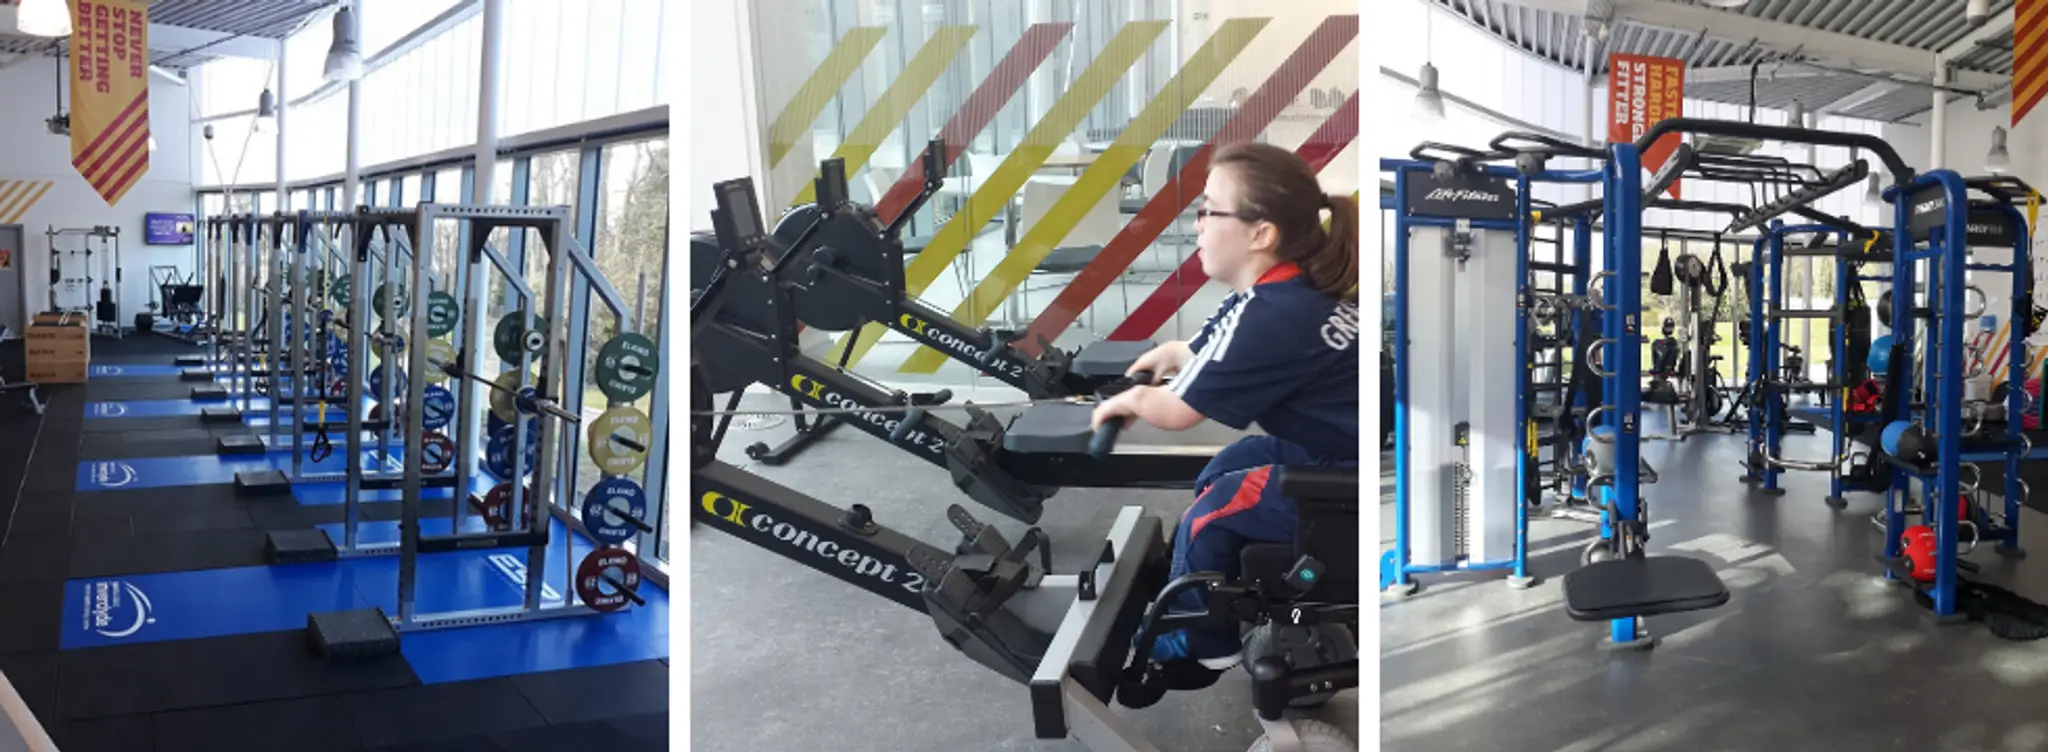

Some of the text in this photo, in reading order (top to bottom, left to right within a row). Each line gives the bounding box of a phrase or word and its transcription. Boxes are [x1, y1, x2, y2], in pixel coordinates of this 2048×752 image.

[78, 1, 93, 81] BETTER
[95, 4, 110, 93] GETTING
[112, 6, 127, 60] STOP
[129, 9, 144, 78] NEVER
[1615, 60, 1631, 124] FITTER
[1631, 62, 1647, 143] STRONG
[1647, 63, 1663, 129] HARDE
[1664, 65, 1680, 119] FASTE
[927, 327, 1009, 371] concet
[825, 392, 928, 445] concet
[751, 513, 928, 594] concept 2
